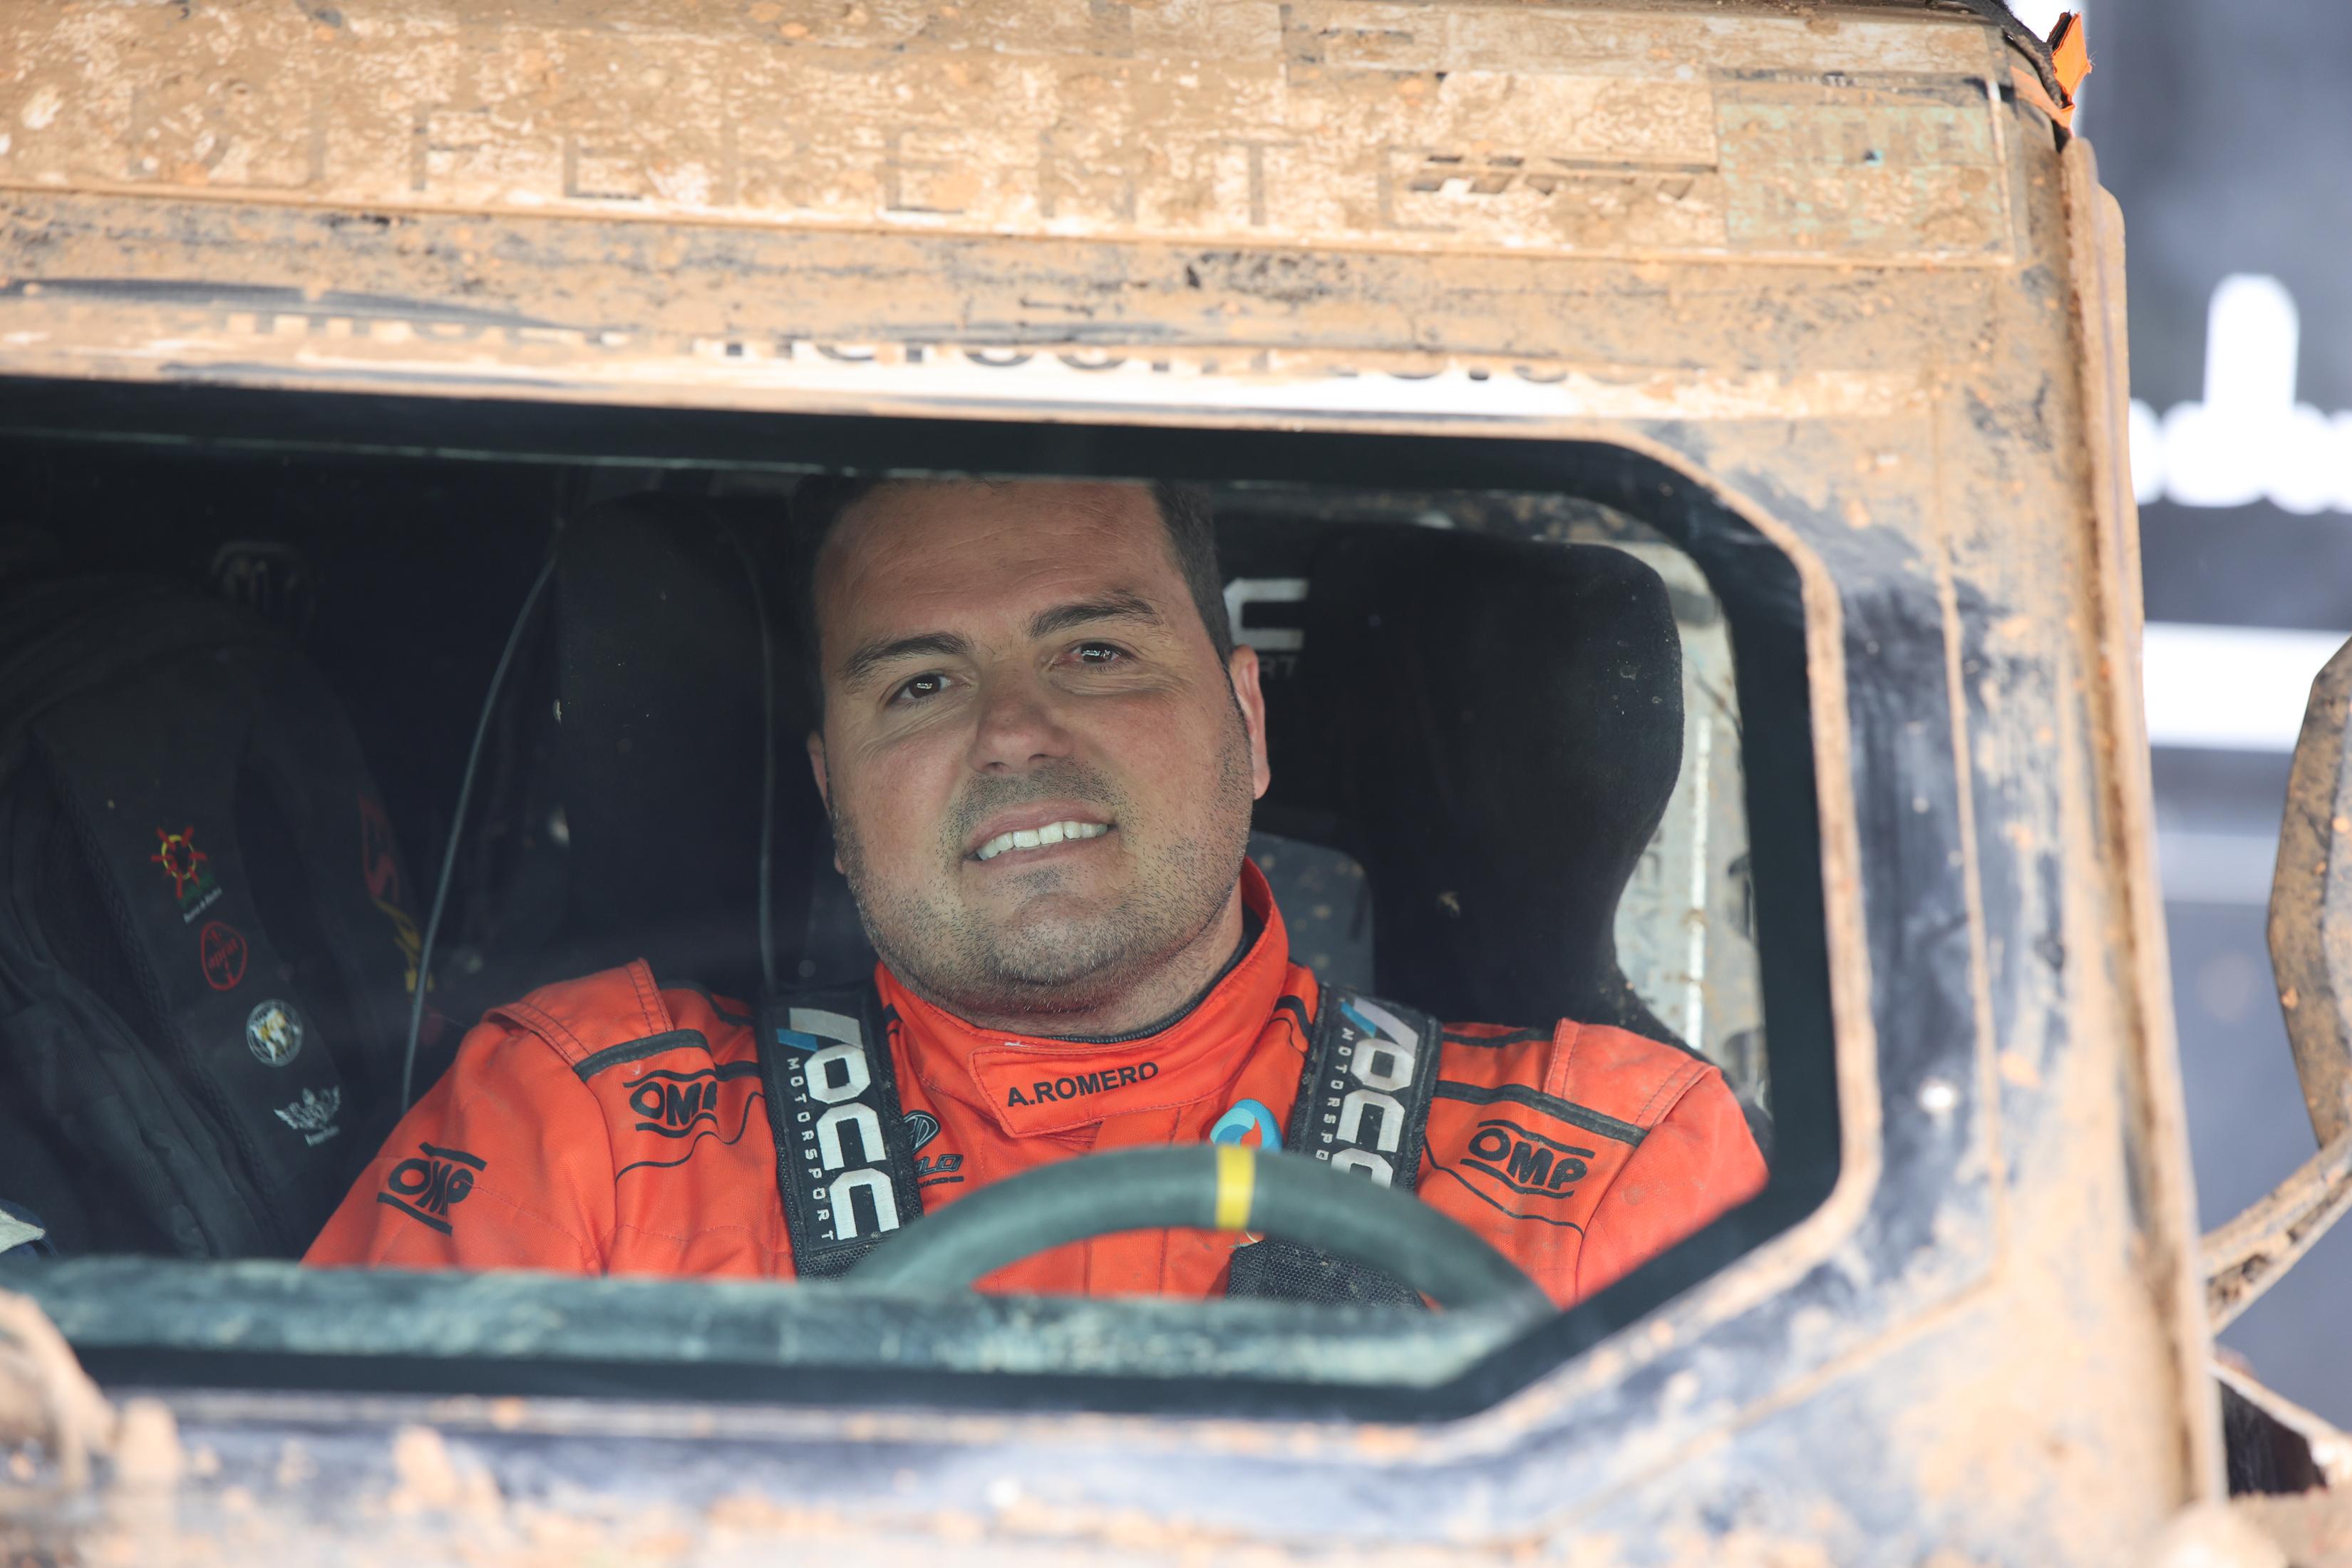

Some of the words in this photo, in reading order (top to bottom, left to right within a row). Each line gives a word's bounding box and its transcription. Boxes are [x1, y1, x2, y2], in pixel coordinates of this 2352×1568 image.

[1007, 1061, 1159, 1107] A.ROMERO
[1315, 1027, 1355, 1161] MOTORSPO
[787, 1057, 835, 1241] MOTORSPORT
[1468, 1127, 1589, 1191] OMP
[386, 1157, 475, 1217] OMP
